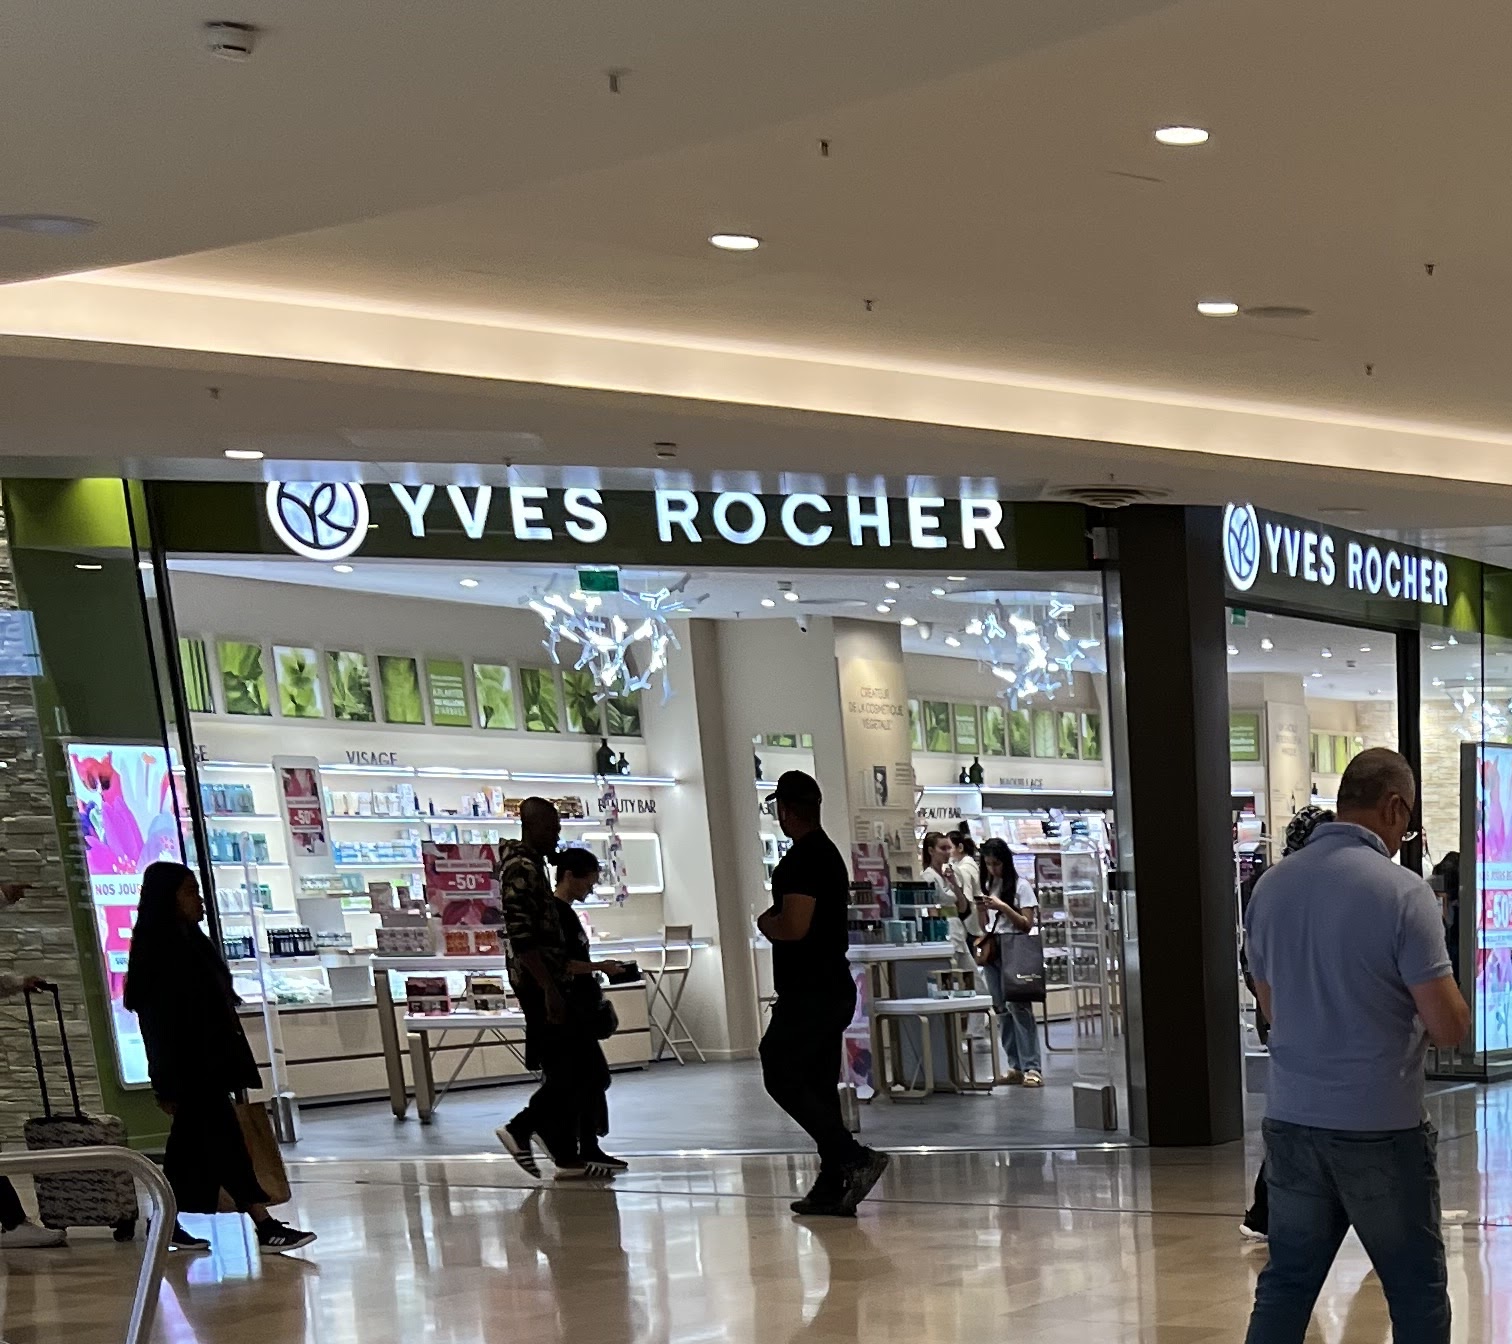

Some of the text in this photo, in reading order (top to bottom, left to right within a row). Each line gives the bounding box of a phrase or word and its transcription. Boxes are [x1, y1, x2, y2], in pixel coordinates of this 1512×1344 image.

[389, 481, 1006, 551] YVES ROCHER
[1264, 520, 1449, 607] YVES ROCHER
[345, 750, 398, 766] VISAGE
[637, 799, 657, 814] BAR
[95, 883, 115, 896] NOS
[448, 873, 485, 890] -50%
